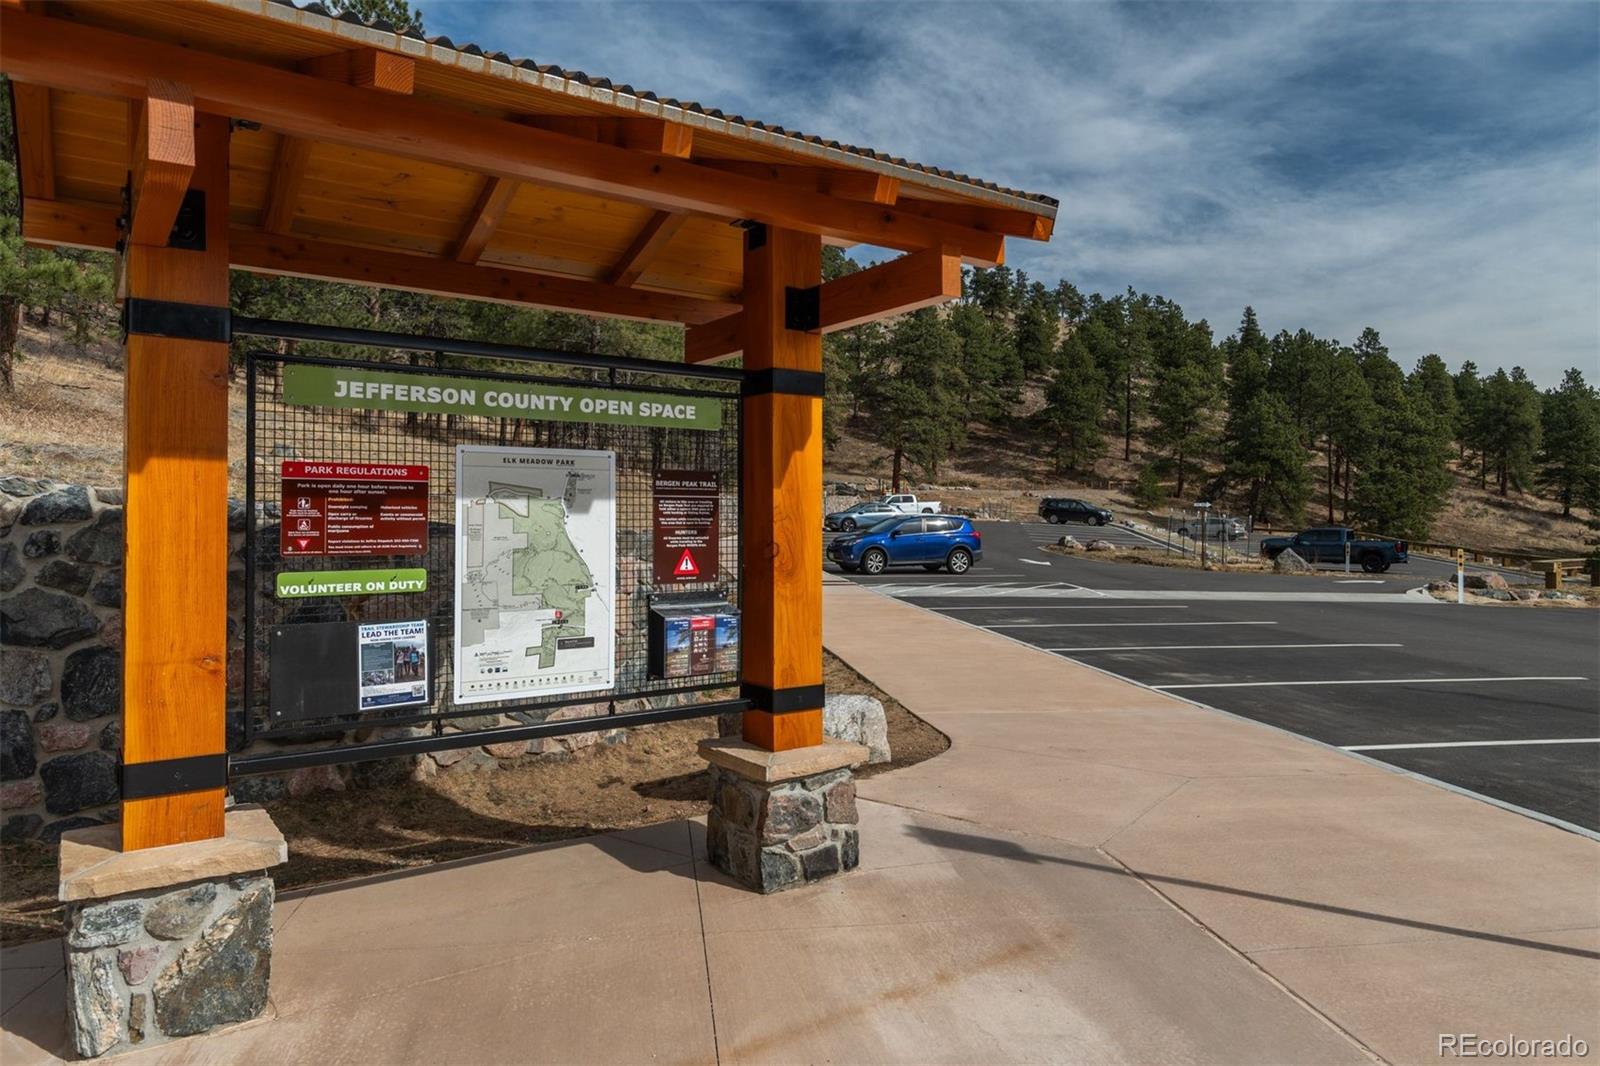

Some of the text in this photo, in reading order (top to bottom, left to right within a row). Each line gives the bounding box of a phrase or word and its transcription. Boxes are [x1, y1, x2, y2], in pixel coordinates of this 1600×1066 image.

[333, 380, 697, 420] JEFFERSON COUNTY OPEN SPACE
[502, 457, 517, 465] ELK
[519, 458, 554, 466] MEADOW
[304, 465, 408, 477] PARK REGULATIONS
[279, 580, 424, 595] VOLUNTEER ON DUTY
[361, 631, 382, 639] LEAD
[401, 628, 424, 636] TEAM!
